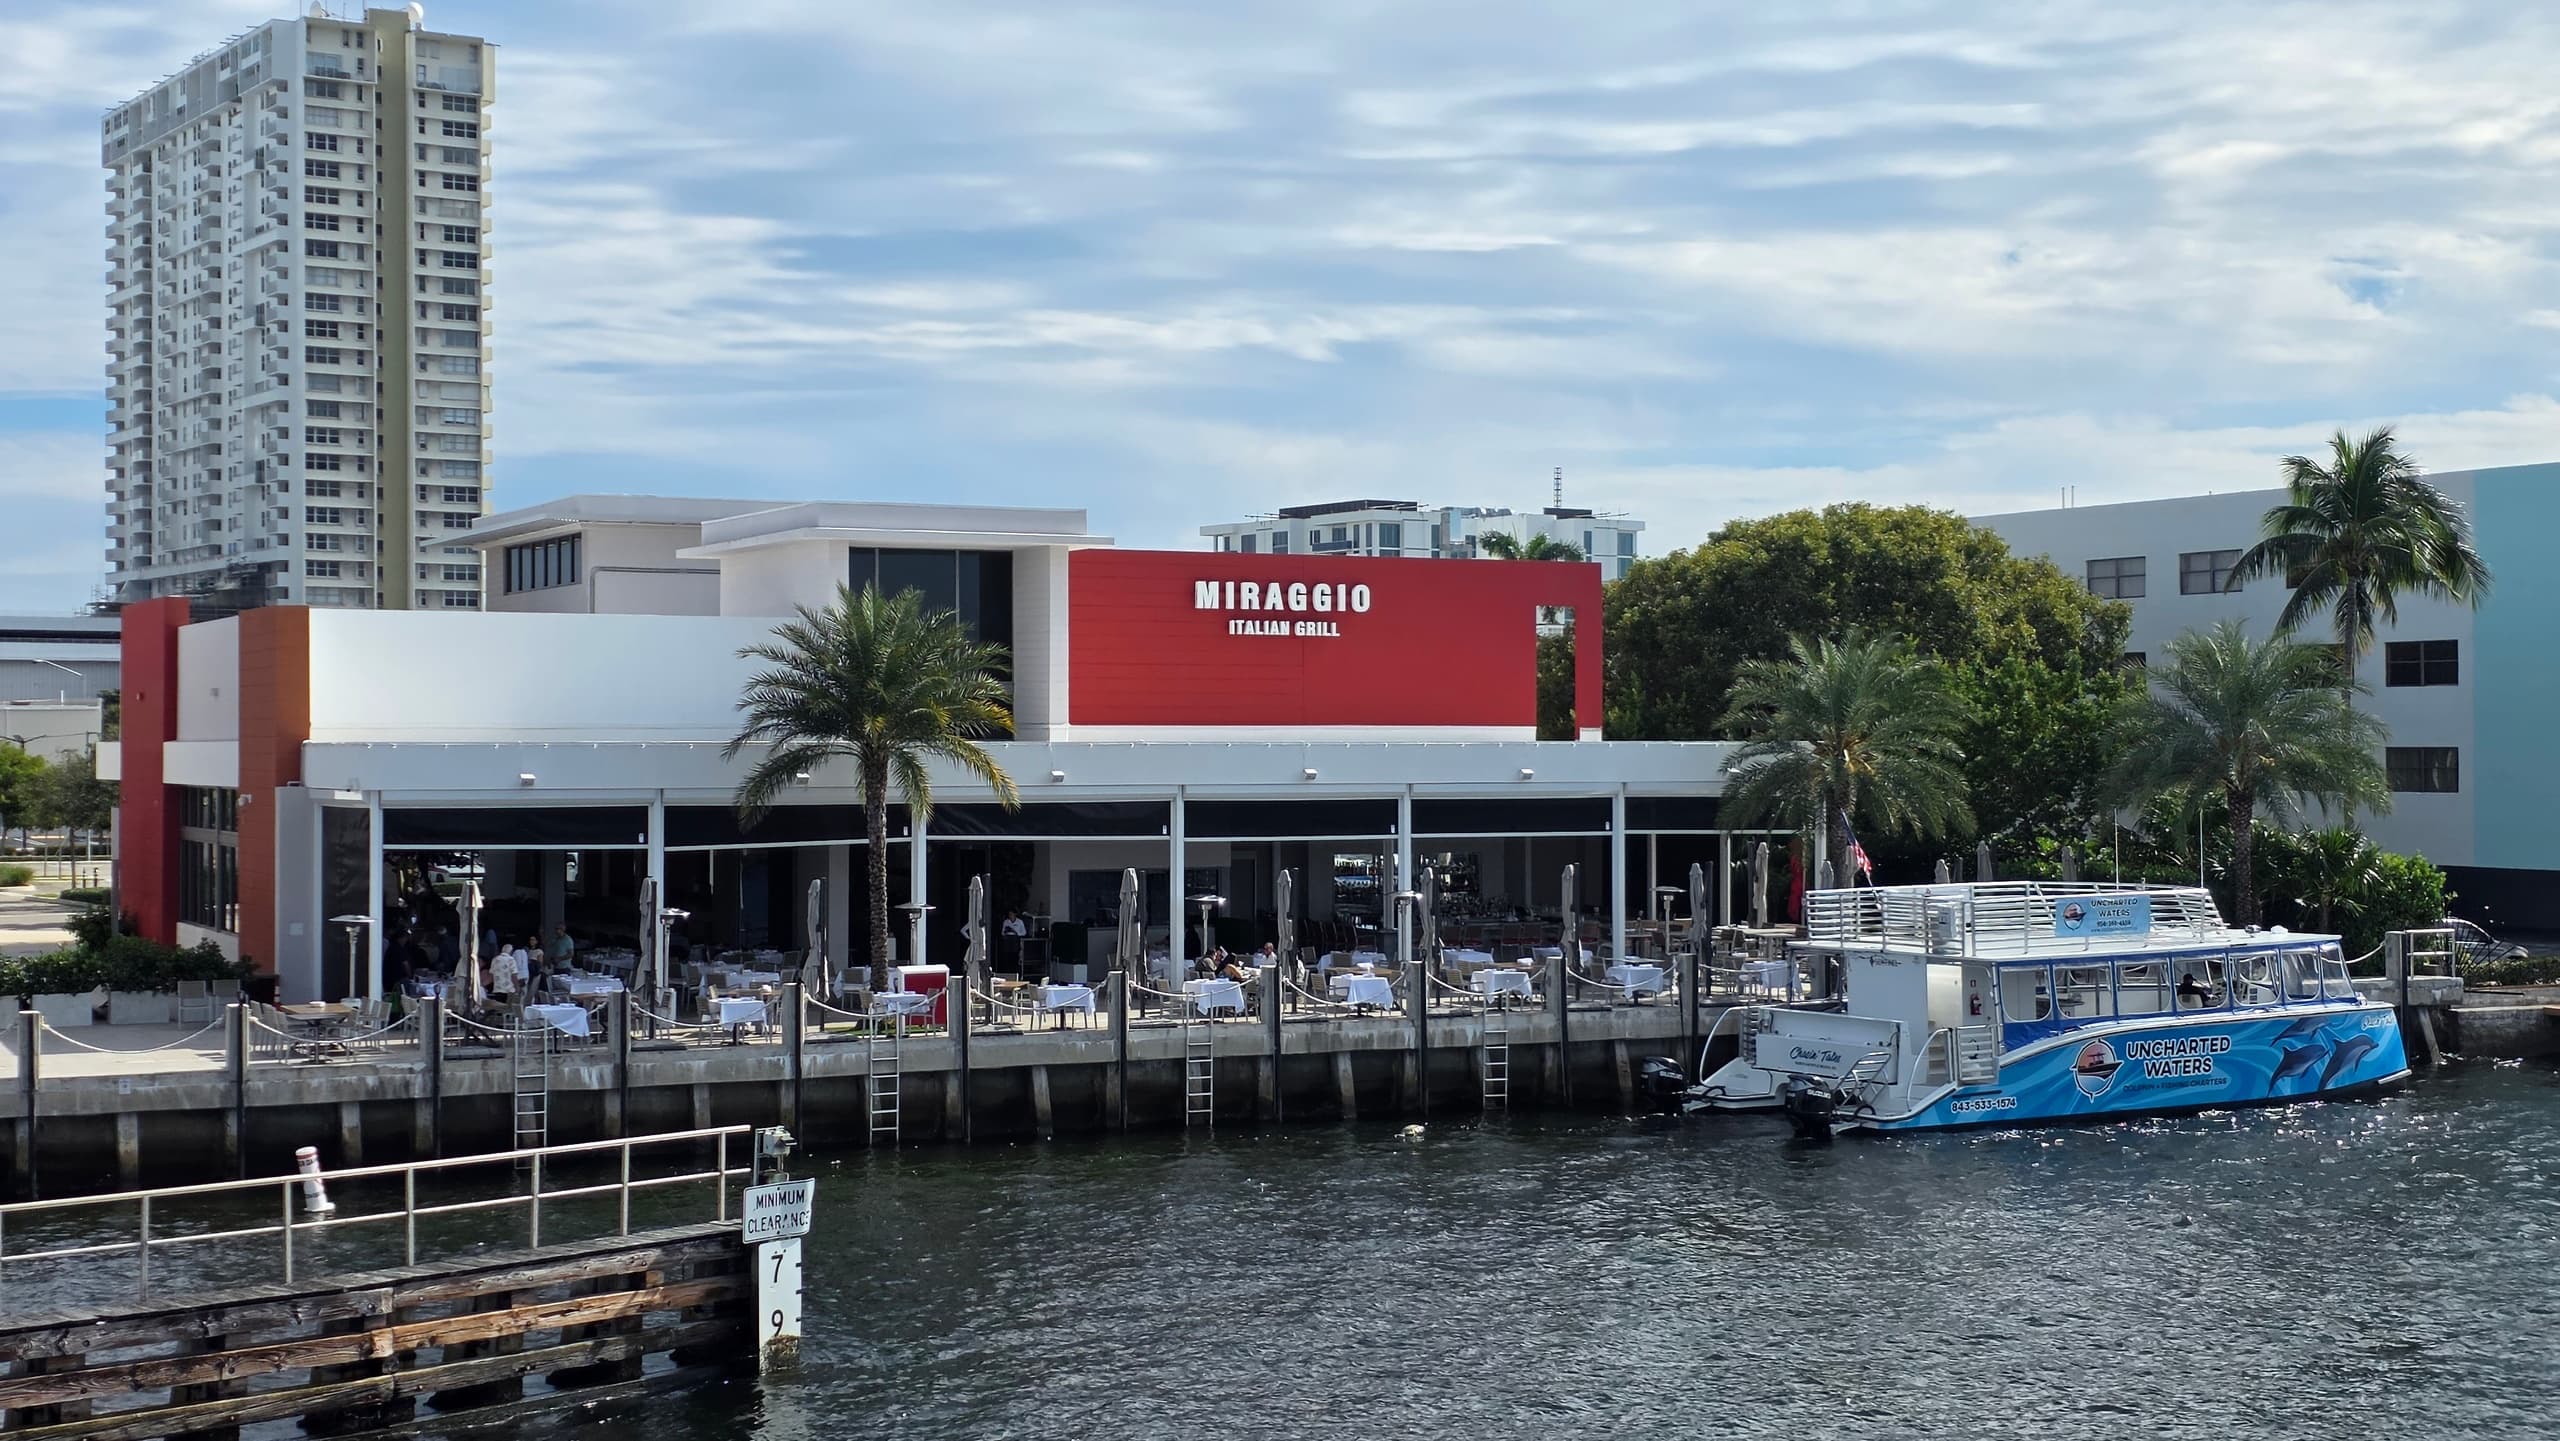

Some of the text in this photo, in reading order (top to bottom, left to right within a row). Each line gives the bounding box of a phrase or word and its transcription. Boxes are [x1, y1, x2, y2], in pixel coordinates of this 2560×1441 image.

[1194, 581, 1371, 612] MIRAGGIO
[1229, 619, 1340, 637] ITALIAN GRILL
[2091, 898, 2138, 907] UNCHARTED
[2098, 909, 2130, 917] WATERS
[2127, 1035, 2231, 1059] UNCHARTED
[2144, 1057, 2213, 1079] WATERS
[1807, 1088, 1831, 1099] SUZUKI
[1951, 1096, 2016, 1113] 843-533-1574
[756, 1189, 805, 1210] MINIMUM
[771, 1254, 784, 1283] 7
[771, 1309, 784, 1336] 9
